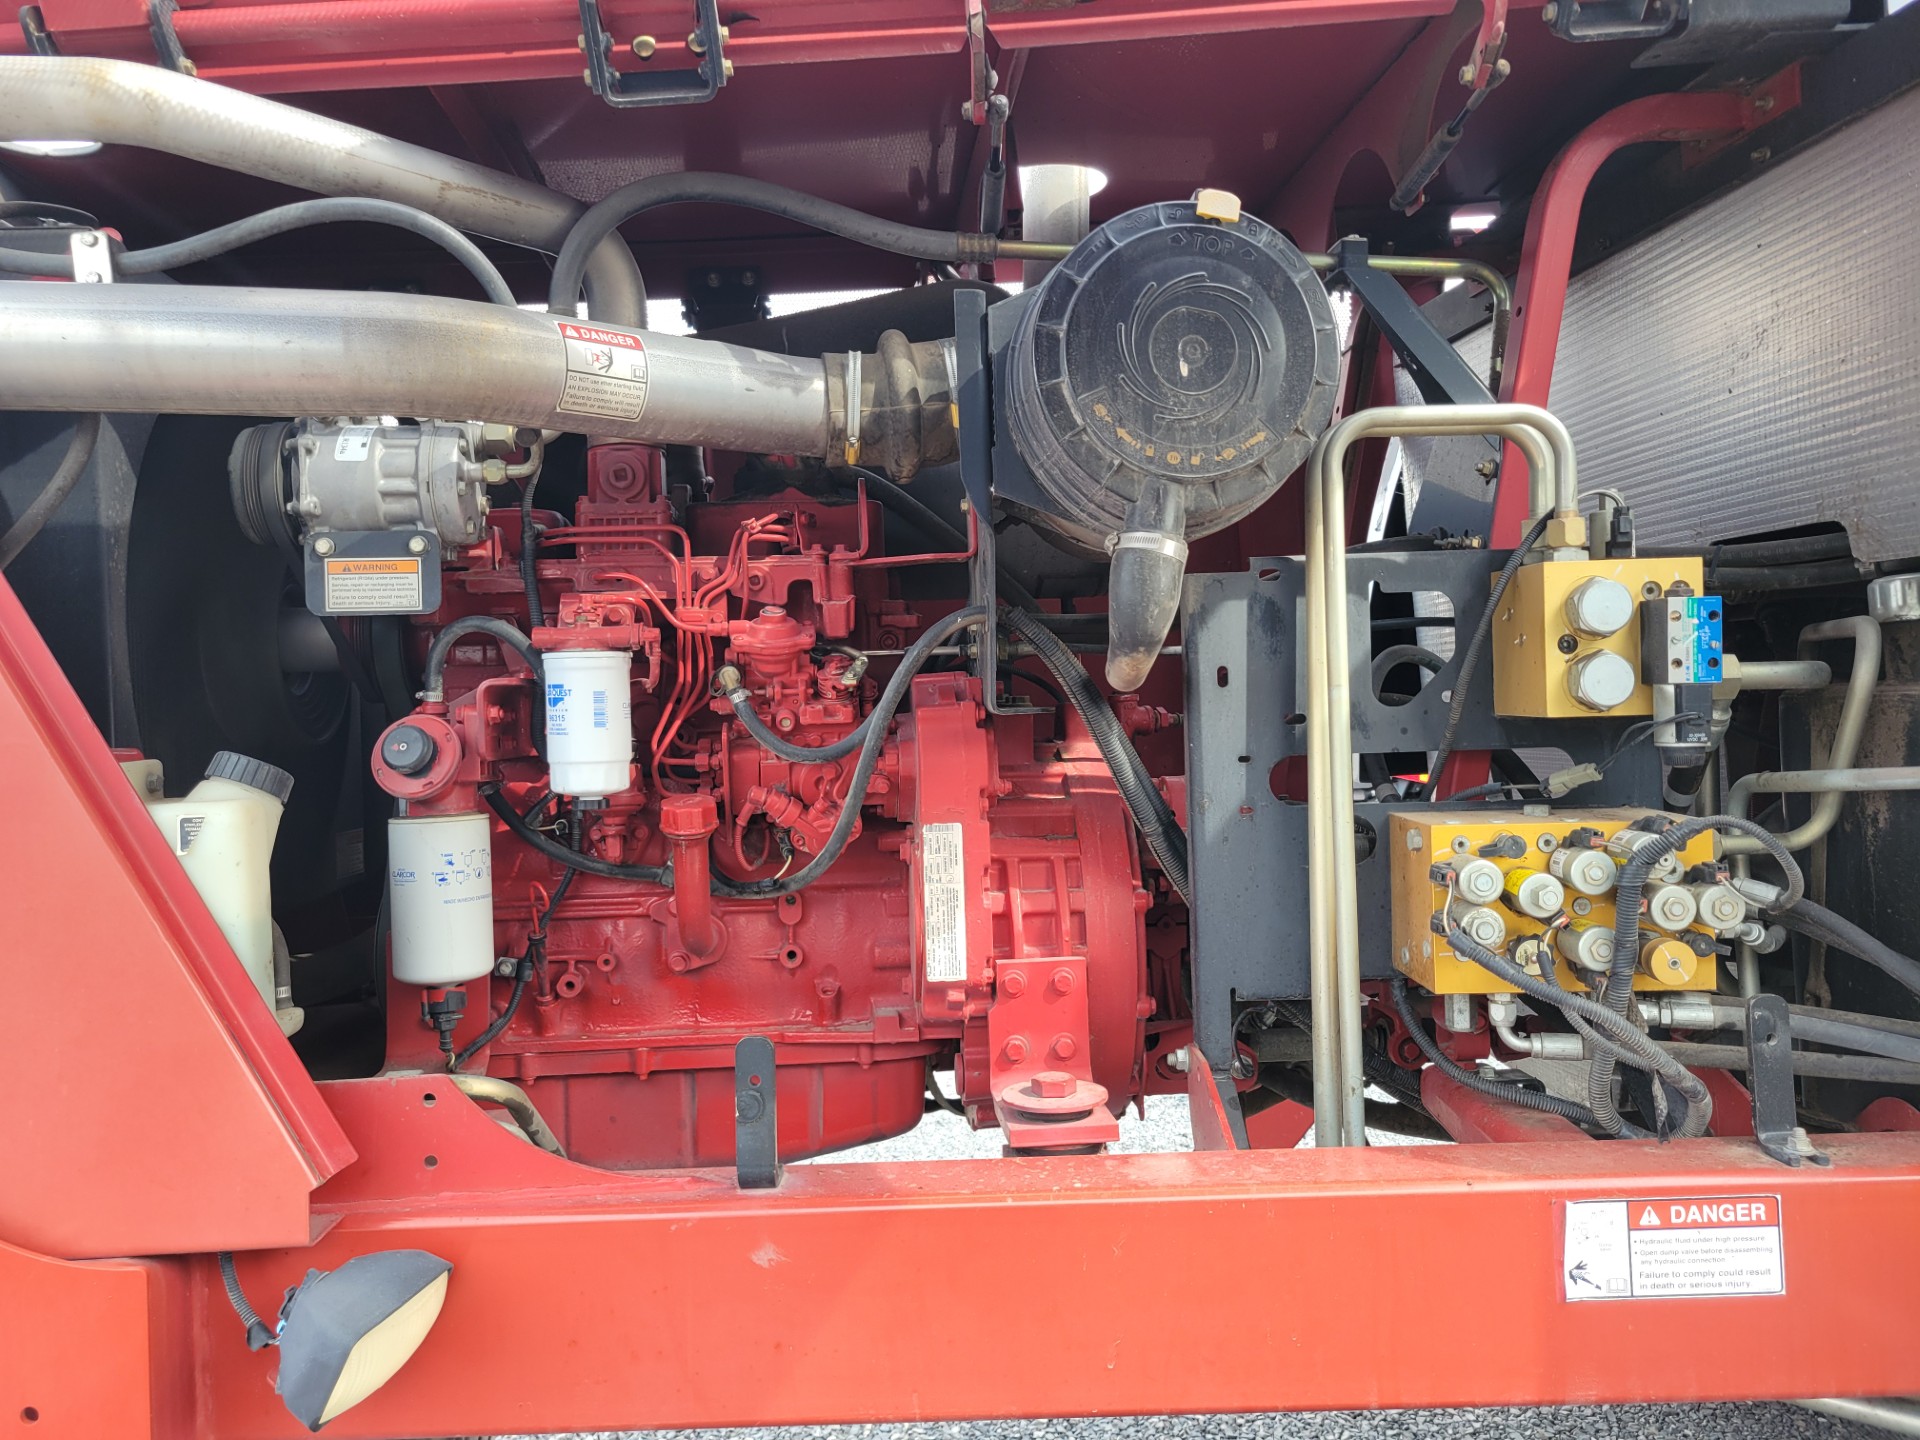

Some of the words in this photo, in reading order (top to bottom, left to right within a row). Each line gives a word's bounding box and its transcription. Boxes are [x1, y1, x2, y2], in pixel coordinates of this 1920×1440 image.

[1193, 232, 1235, 255] TOP
[580, 328, 636, 347] DANGER
[578, 386, 608, 395] EXPLOSION
[566, 392, 586, 401] Failure
[593, 397, 613, 405] comply
[353, 563, 398, 571] WARNING
[1670, 1203, 1766, 1224] DANGER
[1639, 1238, 1673, 1246] Hydraulic
[1715, 1236, 1731, 1244] high
[1660, 1249, 1680, 1257] dump
[1724, 1246, 1774, 1254] disassembling
[1654, 1258, 1686, 1266] hydraulic
[1639, 1271, 1670, 1279] Failure
[1672, 1270, 1681, 1278] to
[1683, 1269, 1716, 1279] comply
[1718, 1268, 1744, 1277] could
[1745, 1268, 1772, 1276] result
[1639, 1281, 1648, 1290] in
[1650, 1281, 1675, 1290] death
[1689, 1280, 1722, 1289] serious
